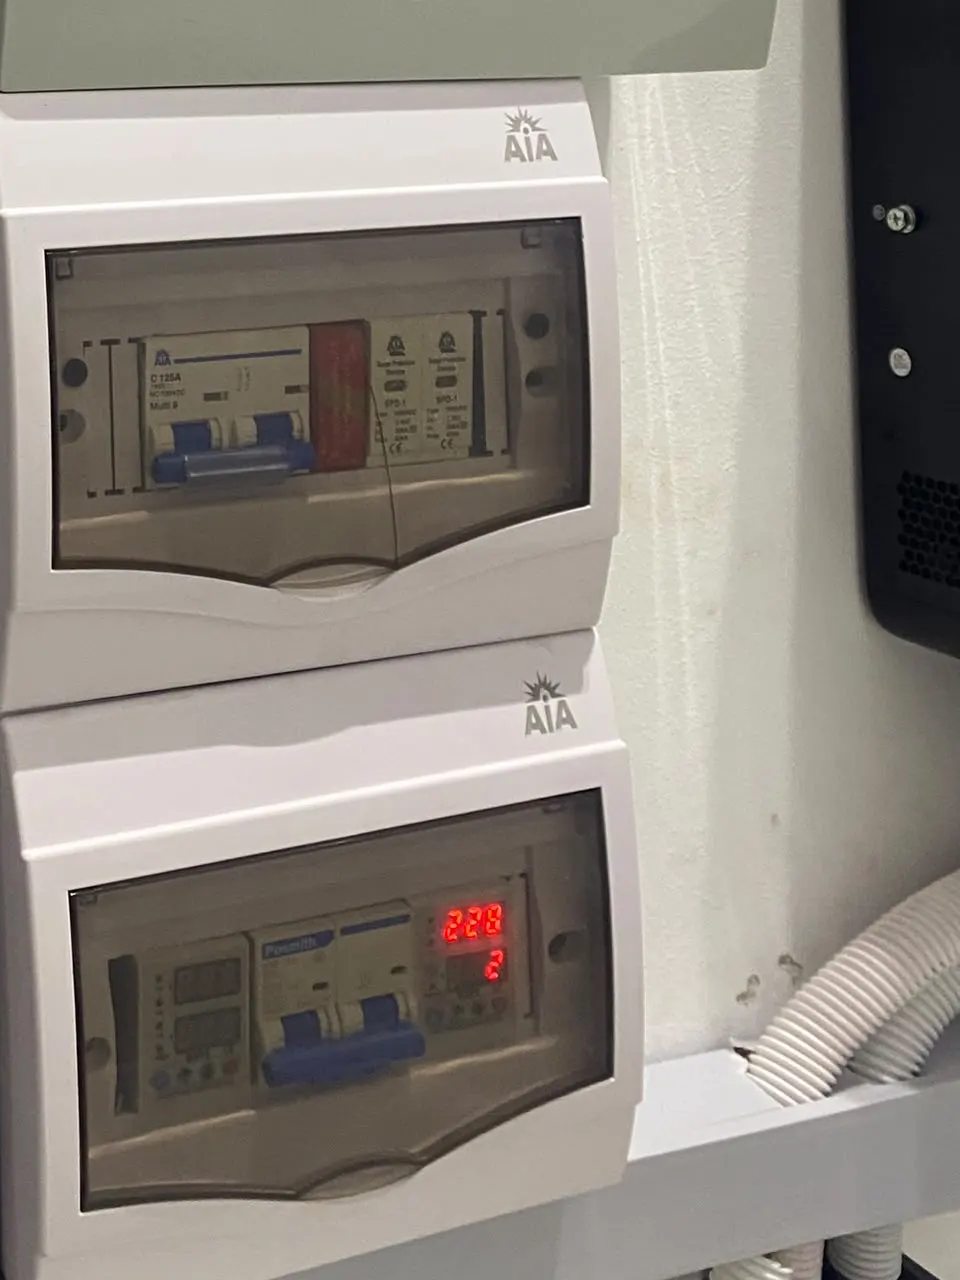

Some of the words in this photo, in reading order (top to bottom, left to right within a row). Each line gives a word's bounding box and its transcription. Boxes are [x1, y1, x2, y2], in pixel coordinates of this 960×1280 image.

[504, 123, 558, 162] AIA
[524, 695, 578, 736] AIA
[443, 904, 502, 944] 228
[485, 949, 504, 981] 2
